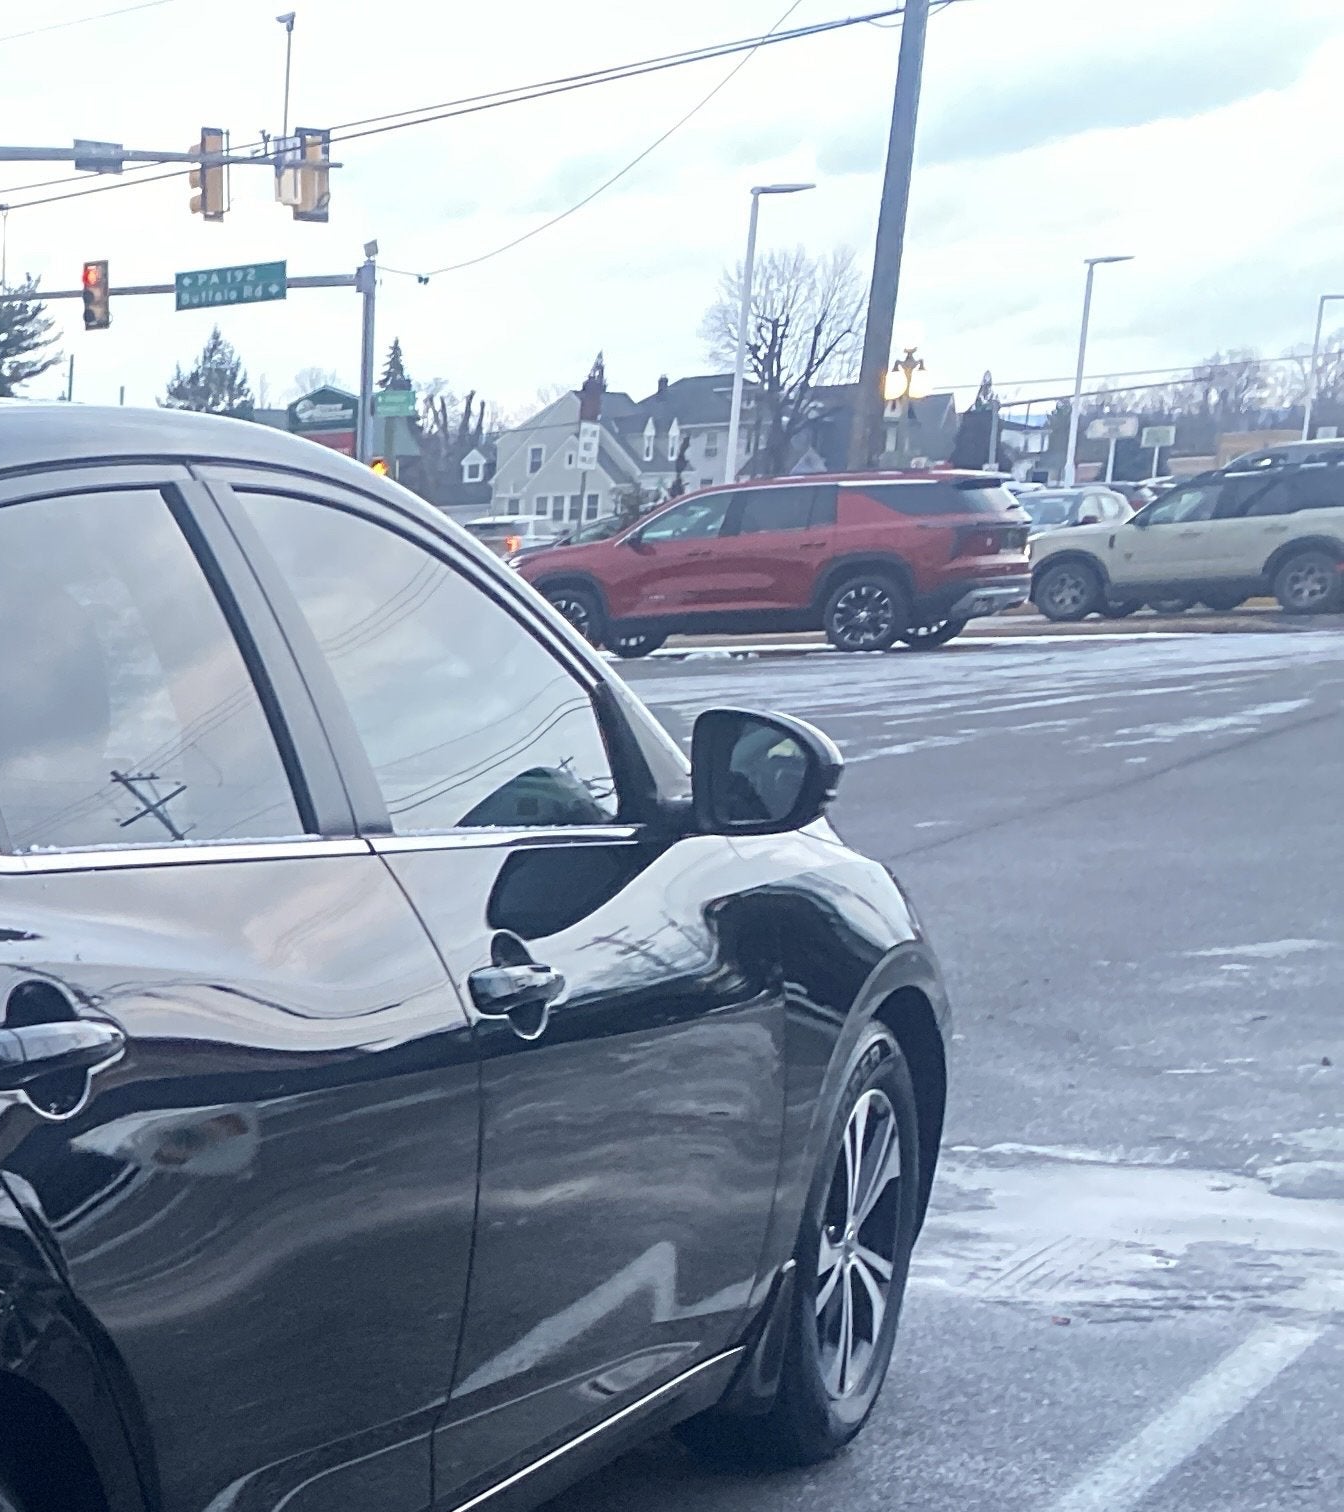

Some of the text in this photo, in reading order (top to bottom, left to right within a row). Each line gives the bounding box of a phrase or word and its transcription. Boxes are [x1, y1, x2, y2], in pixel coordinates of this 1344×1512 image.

[197, 267, 256, 286] PA 192
[180, 283, 263, 306] Buffalo Rd
